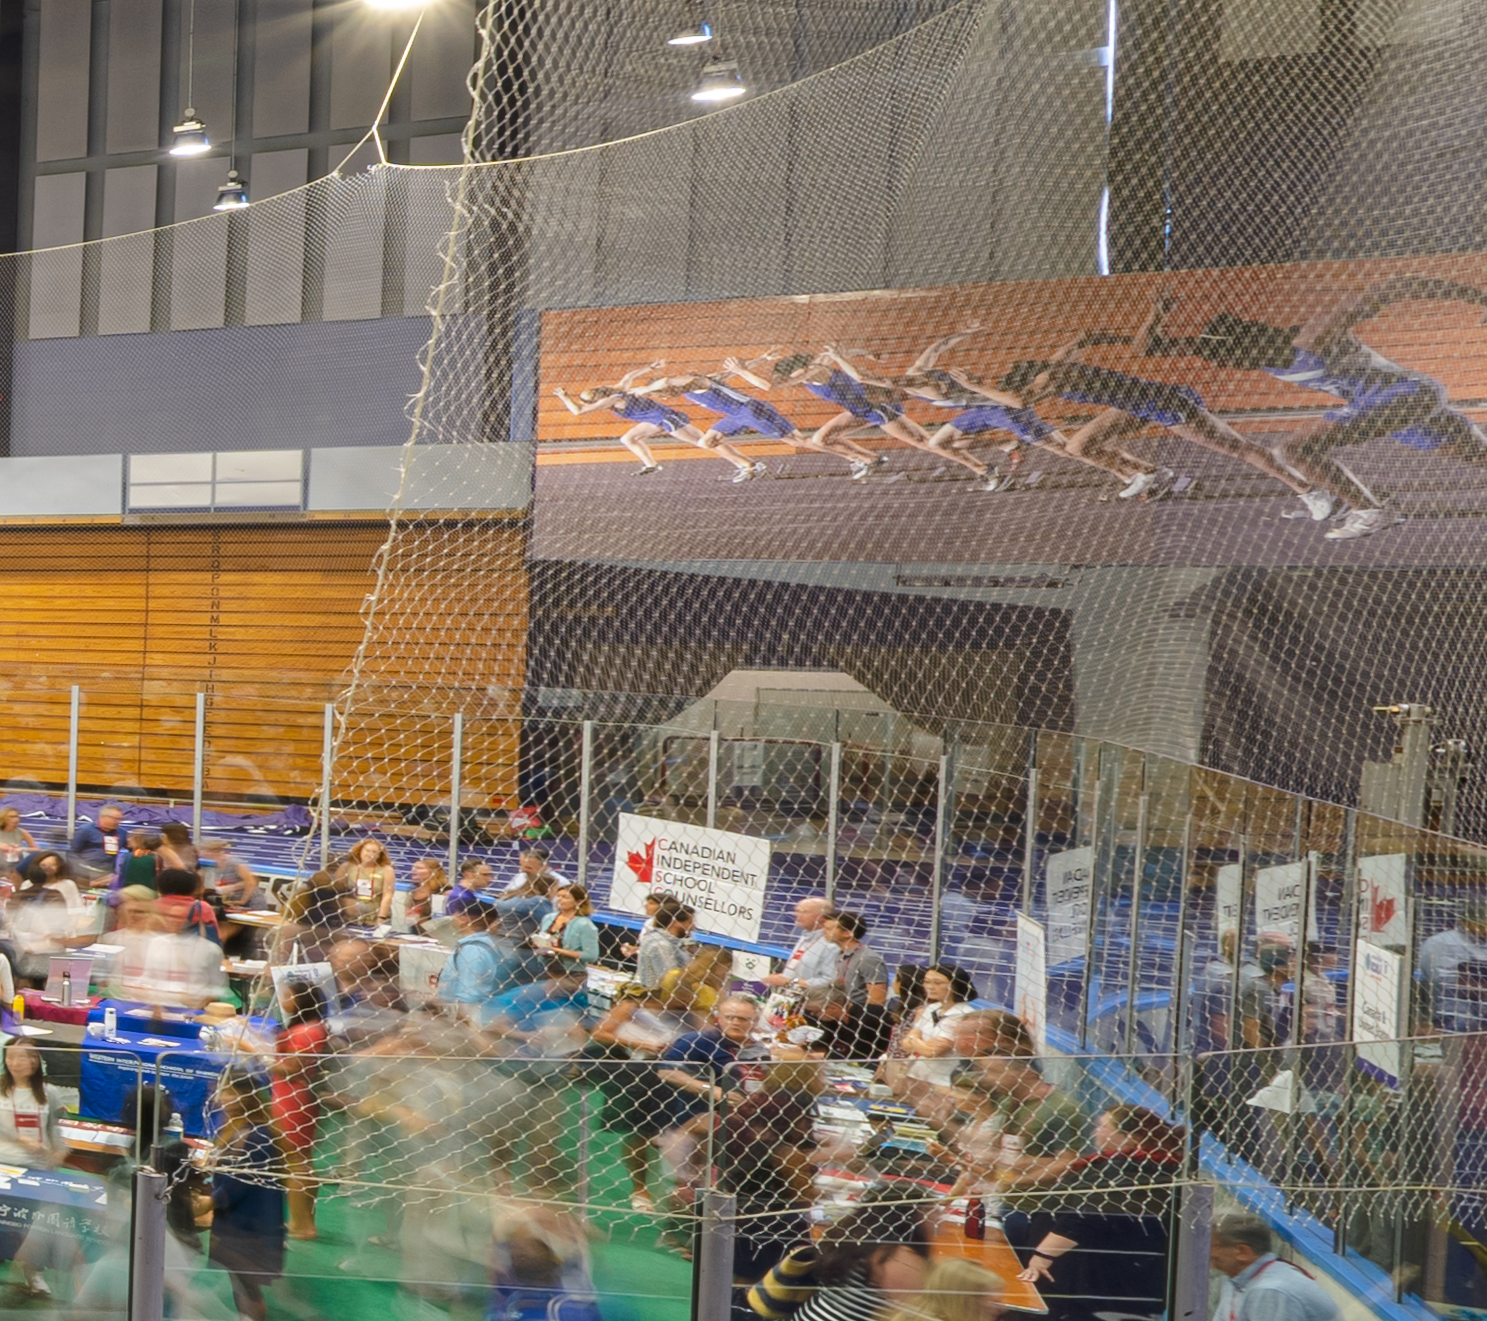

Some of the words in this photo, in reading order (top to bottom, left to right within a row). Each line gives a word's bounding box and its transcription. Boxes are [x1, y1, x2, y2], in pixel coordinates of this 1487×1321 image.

[658, 838, 736, 864] CANADIAN
[655, 871, 715, 894] SCHOOL
[656, 855, 757, 887] INDEPENDENT
